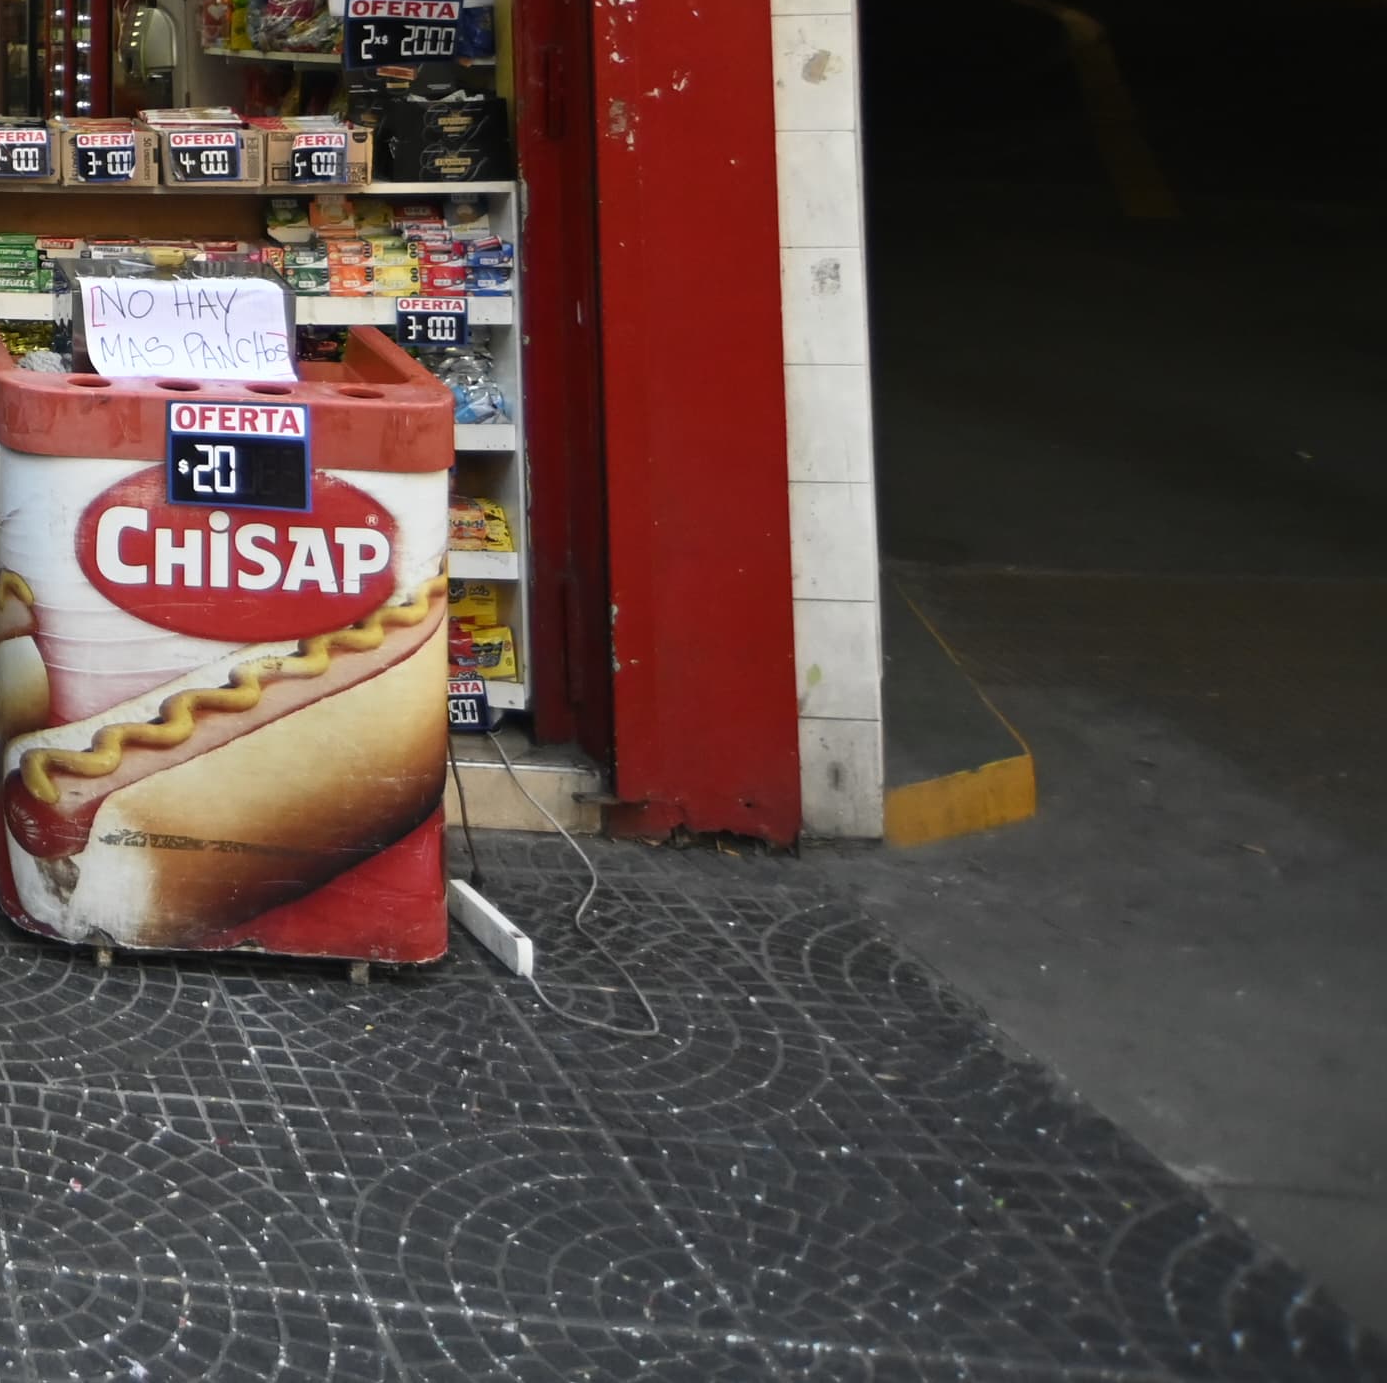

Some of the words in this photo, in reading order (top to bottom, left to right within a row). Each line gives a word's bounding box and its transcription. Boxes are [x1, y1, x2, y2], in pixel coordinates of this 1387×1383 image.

[352, 0, 455, 18] OFERTA
[401, 25, 456, 56] 2000
[171, 134, 235, 146] OFERTA
[99, 282, 155, 319] NO
[174, 284, 238, 336] HAY
[399, 299, 463, 312] OFERTA
[100, 333, 175, 369] MAS
[175, 405, 301, 435] OFERTA
